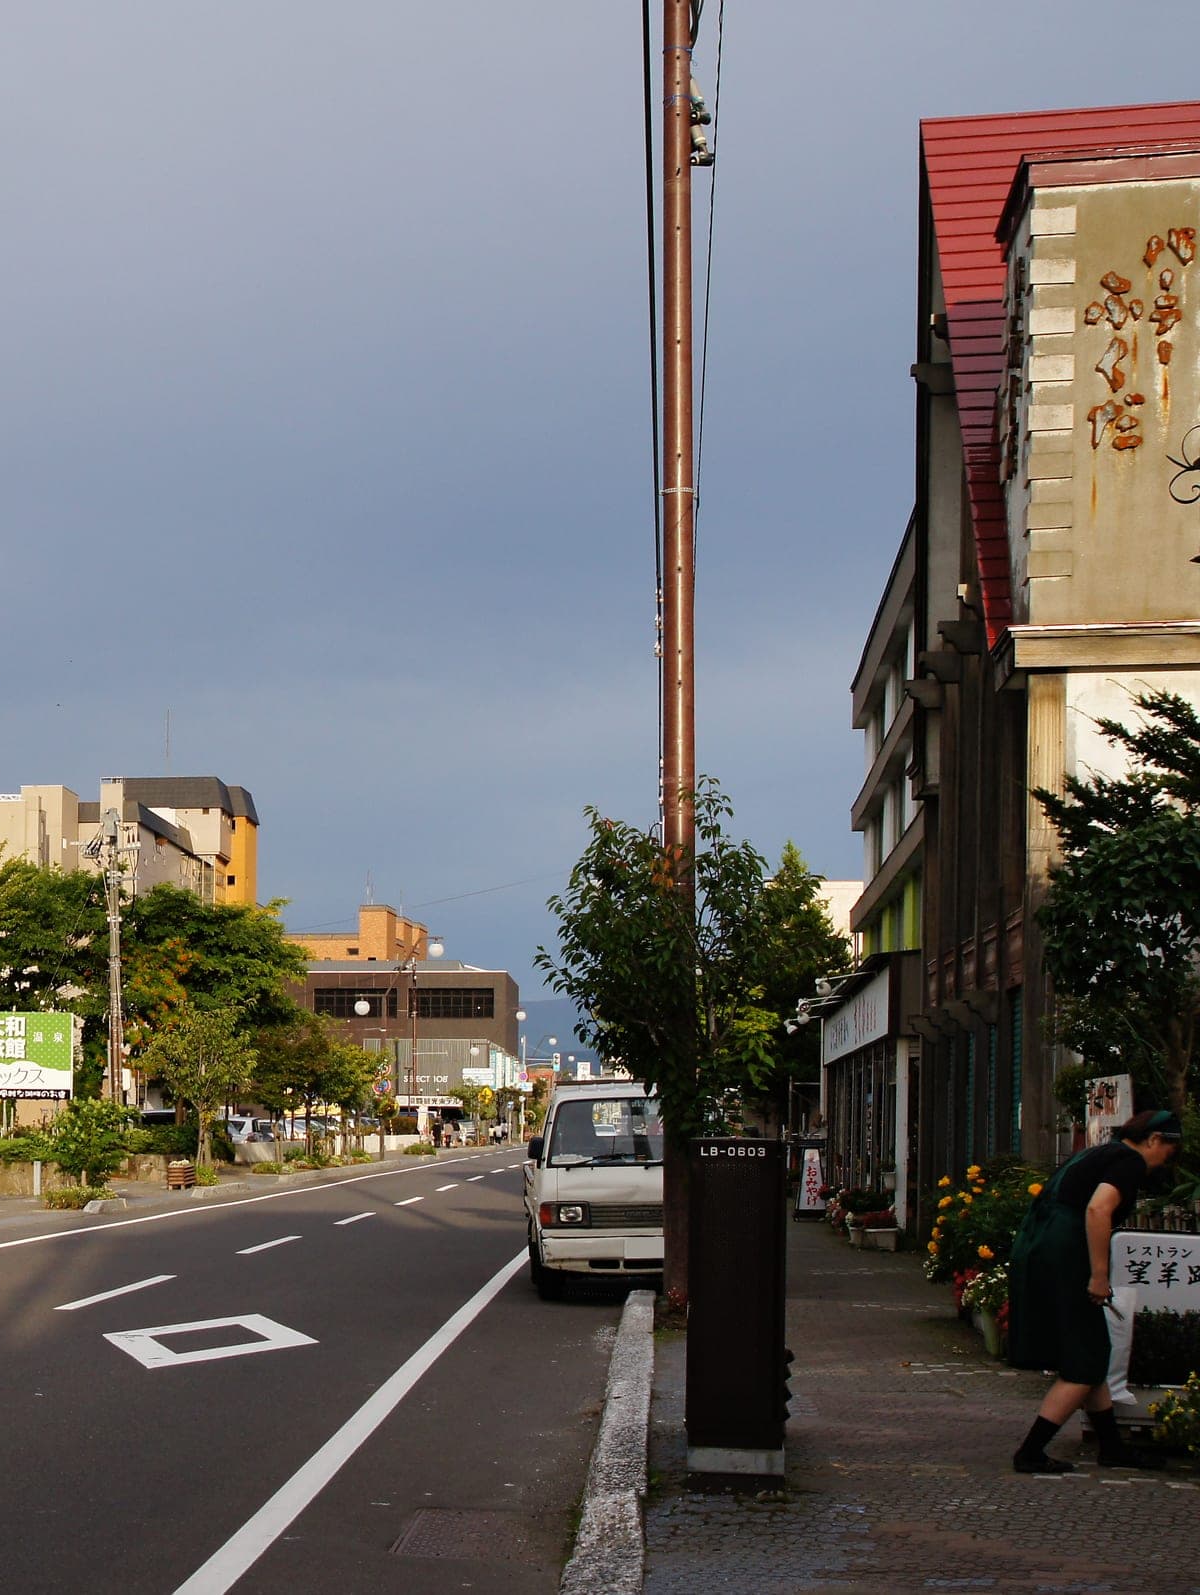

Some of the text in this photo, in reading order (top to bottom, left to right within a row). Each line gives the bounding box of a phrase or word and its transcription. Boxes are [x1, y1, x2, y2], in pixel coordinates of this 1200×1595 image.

[33, 1031, 64, 1043] 温泉
[403, 1075, 449, 1083] SEECT 108
[700, 1146, 766, 1157] LB-0603
[805, 1166, 817, 1206] おみやげ
[1126, 1245, 1193, 1258] レストラン
